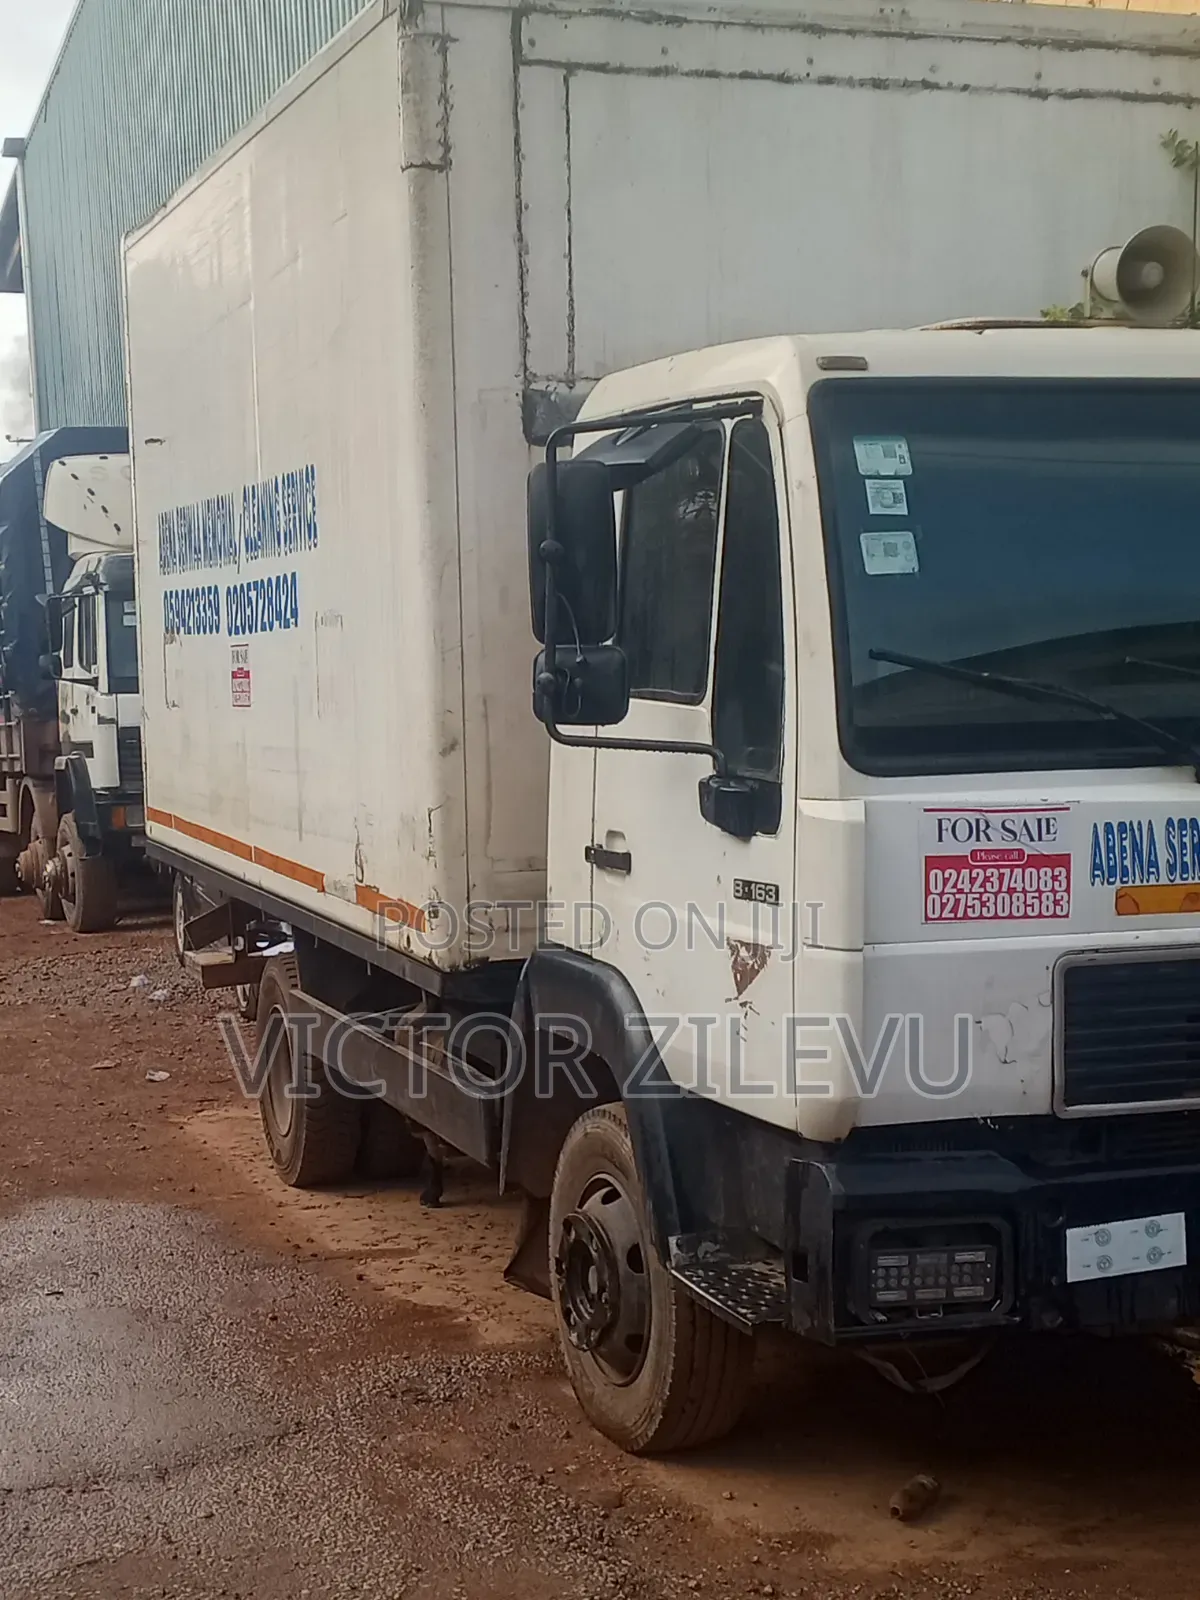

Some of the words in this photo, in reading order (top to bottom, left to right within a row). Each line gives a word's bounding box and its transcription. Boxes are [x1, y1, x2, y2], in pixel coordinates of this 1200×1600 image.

[243, 475, 281, 564] CLEANING
[282, 464, 317, 556] SERVICE
[163, 584, 221, 636] 0594213359
[225, 571, 299, 637] 0205728424
[937, 817, 993, 843] FOR
[1001, 816, 1058, 843] SALE
[976, 851, 1002, 861] Please
[1005, 850, 1020, 861] call
[1089, 818, 1161, 887] ABENA
[929, 866, 1068, 894] 0242374083
[927, 890, 1070, 918] 0275308583
